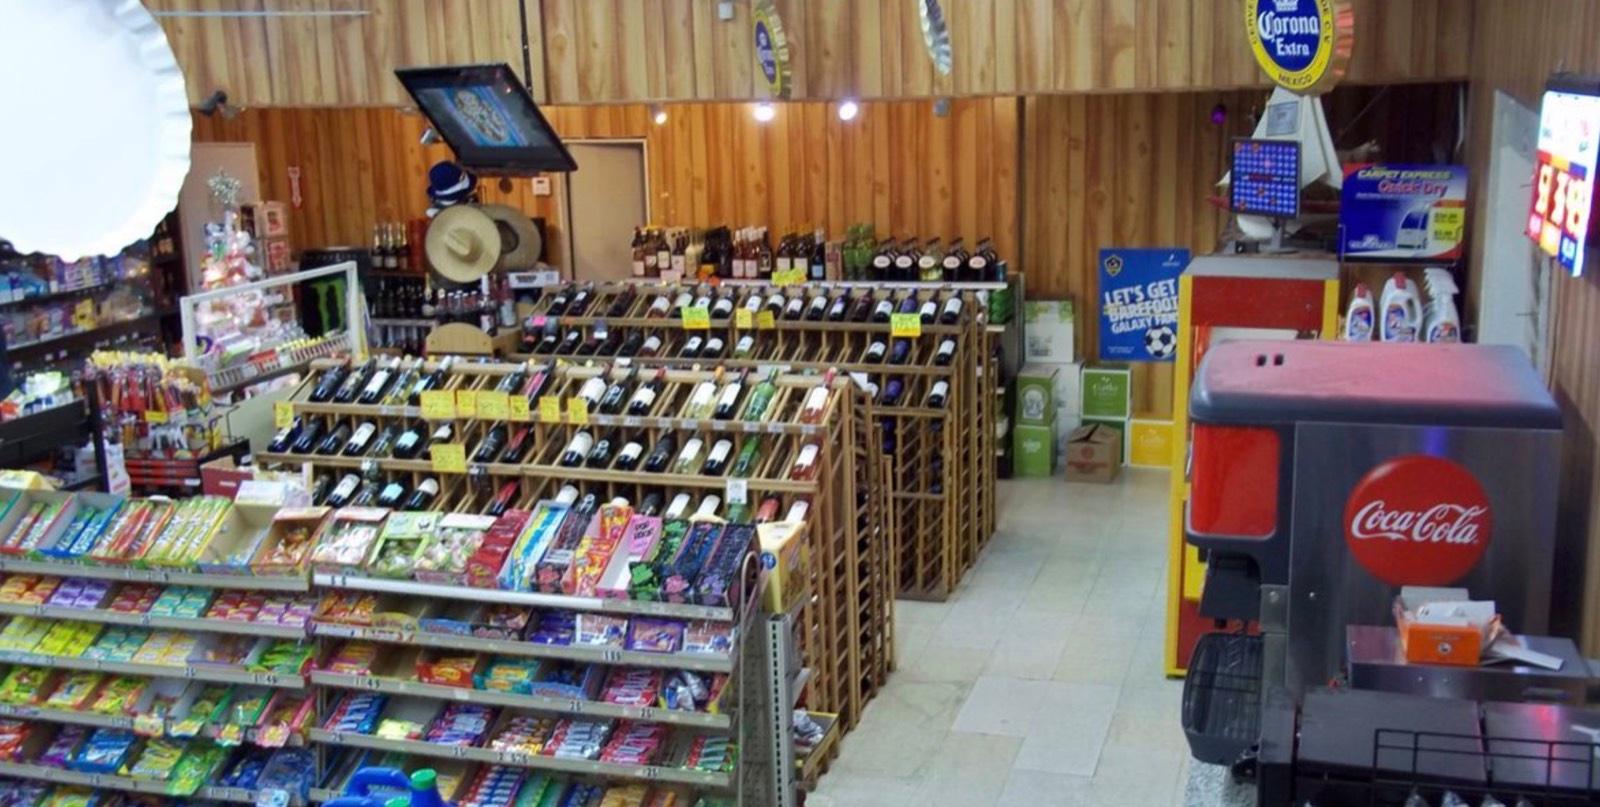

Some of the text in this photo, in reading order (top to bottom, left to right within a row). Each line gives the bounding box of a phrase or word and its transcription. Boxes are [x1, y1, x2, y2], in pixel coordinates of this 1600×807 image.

[1257, 10, 1320, 40] Corona
[1276, 37, 1310, 56] Extra
[1423, 181, 1448, 198] Dry
[1104, 279, 1176, 305] LET'S GET
[1111, 315, 1152, 334] GALAXY
[1351, 500, 1489, 544] Coca-Cola
